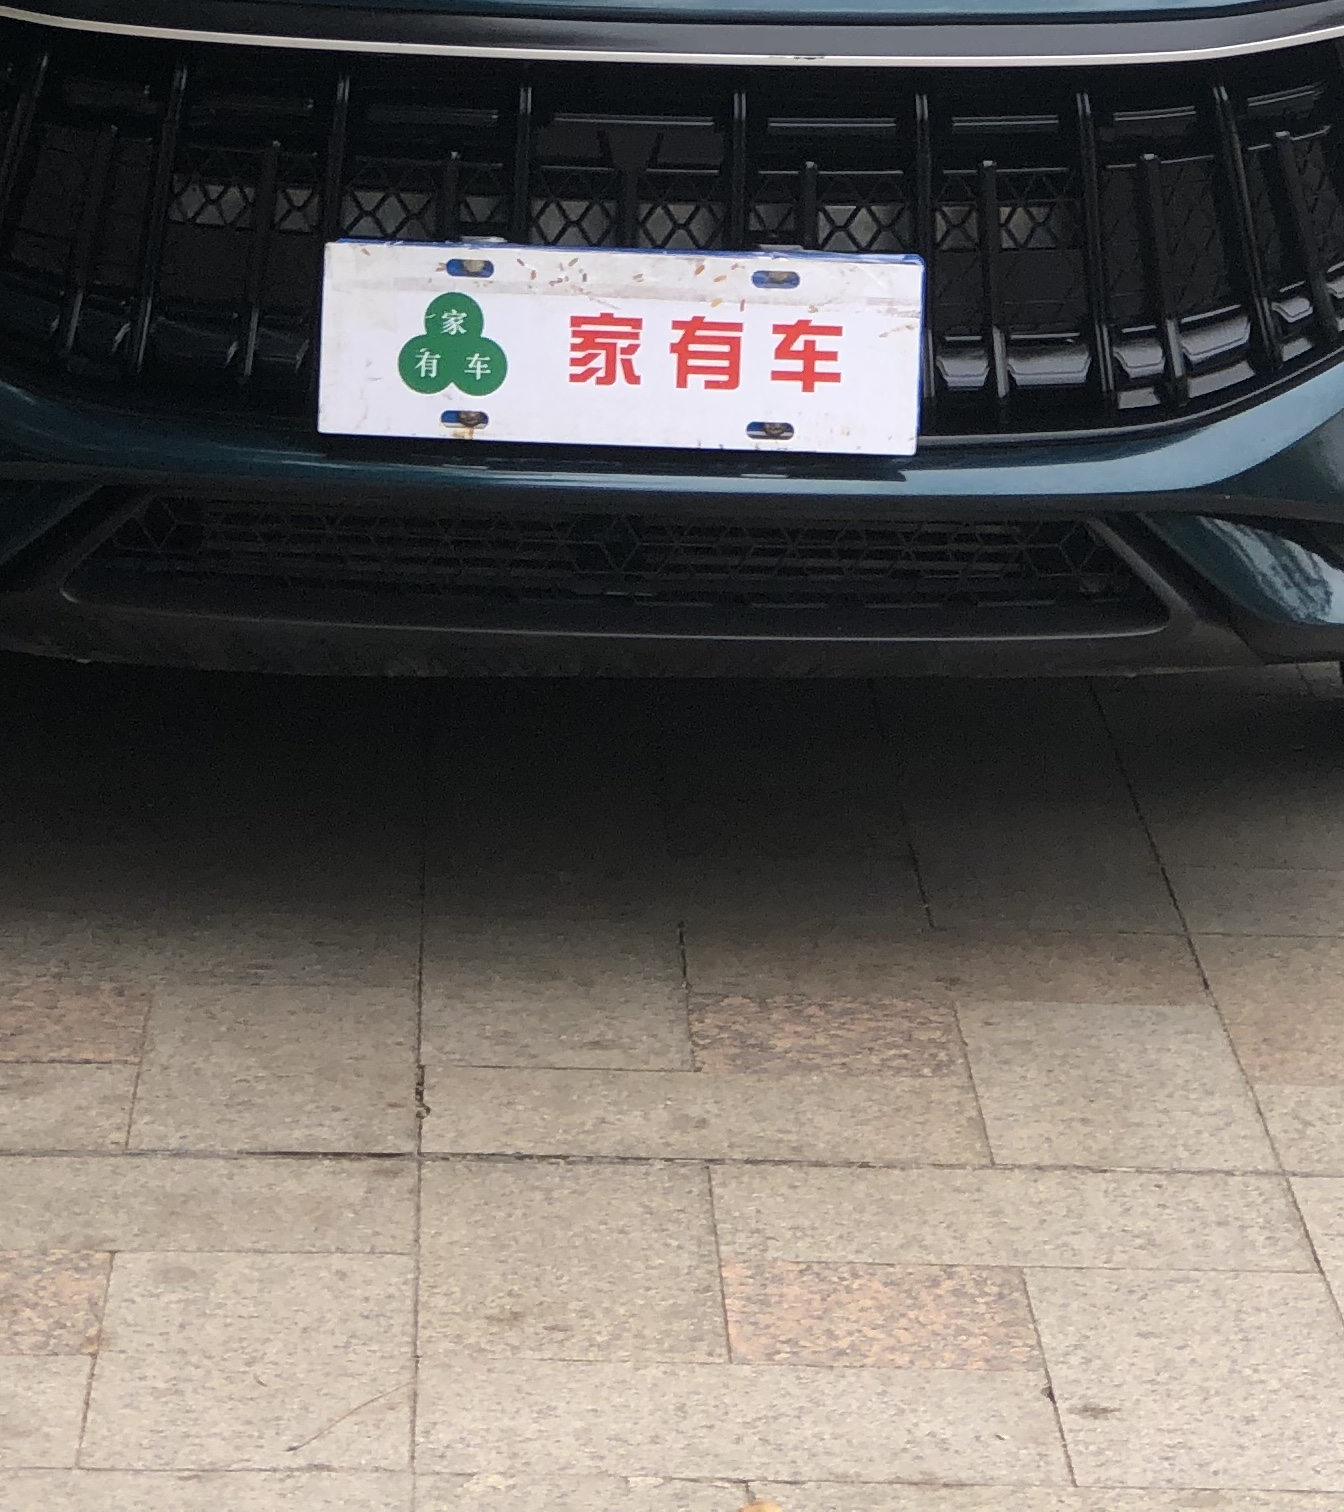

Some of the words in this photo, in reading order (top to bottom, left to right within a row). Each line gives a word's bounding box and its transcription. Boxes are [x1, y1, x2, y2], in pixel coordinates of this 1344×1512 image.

[440, 308, 468, 336] 家
[567, 312, 845, 394] 家有车
